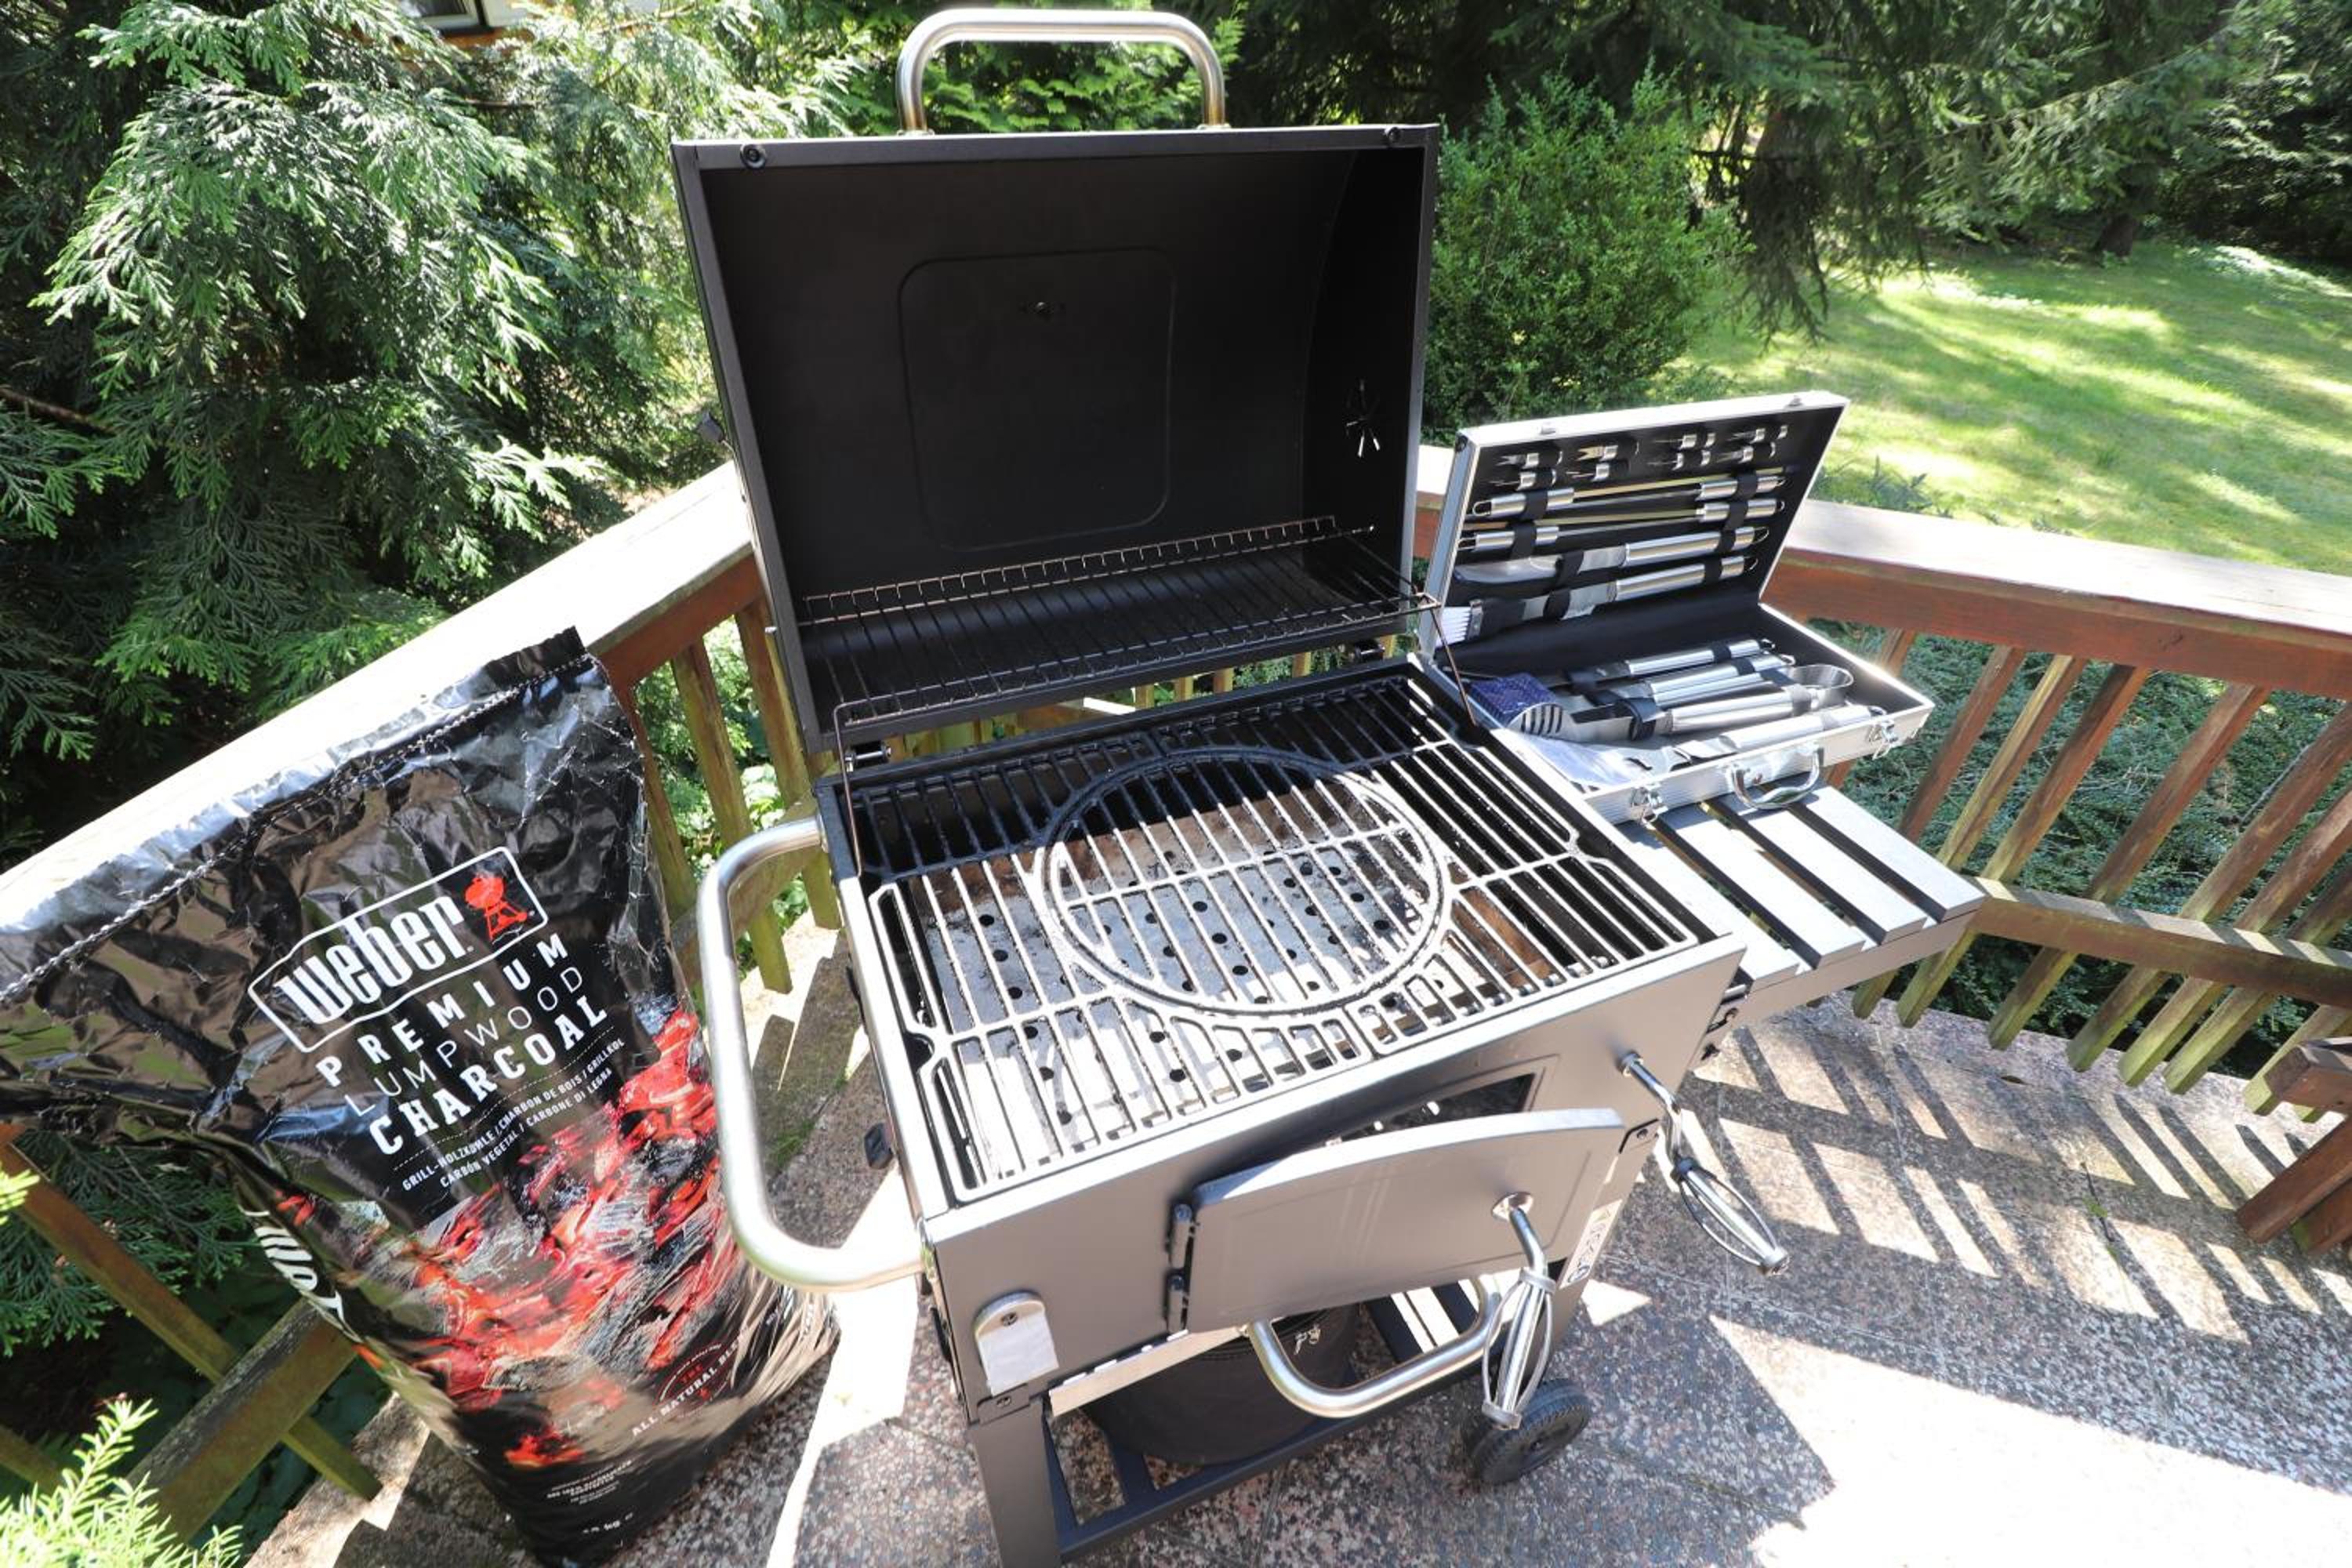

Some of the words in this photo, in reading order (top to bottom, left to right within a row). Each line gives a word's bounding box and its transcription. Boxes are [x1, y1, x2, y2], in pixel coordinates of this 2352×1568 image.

[316, 933, 568, 1087] PREMIUM
[344, 967, 583, 1116] LUMPWOOD
[369, 995, 608, 1155] CHARCOAL
[484, 1130, 518, 1166] VEGETAL
[526, 1099, 573, 1127] CARBONE
[575, 1091, 586, 1103] DI
[588, 1067, 612, 1094] LEGNA
[499, 1094, 542, 1131] CHARBON
[543, 1088, 557, 1102] DE
[558, 1075, 583, 1094] BOIS
[632, 1416, 658, 1436] ALL
[660, 1367, 717, 1416] NATURAL
